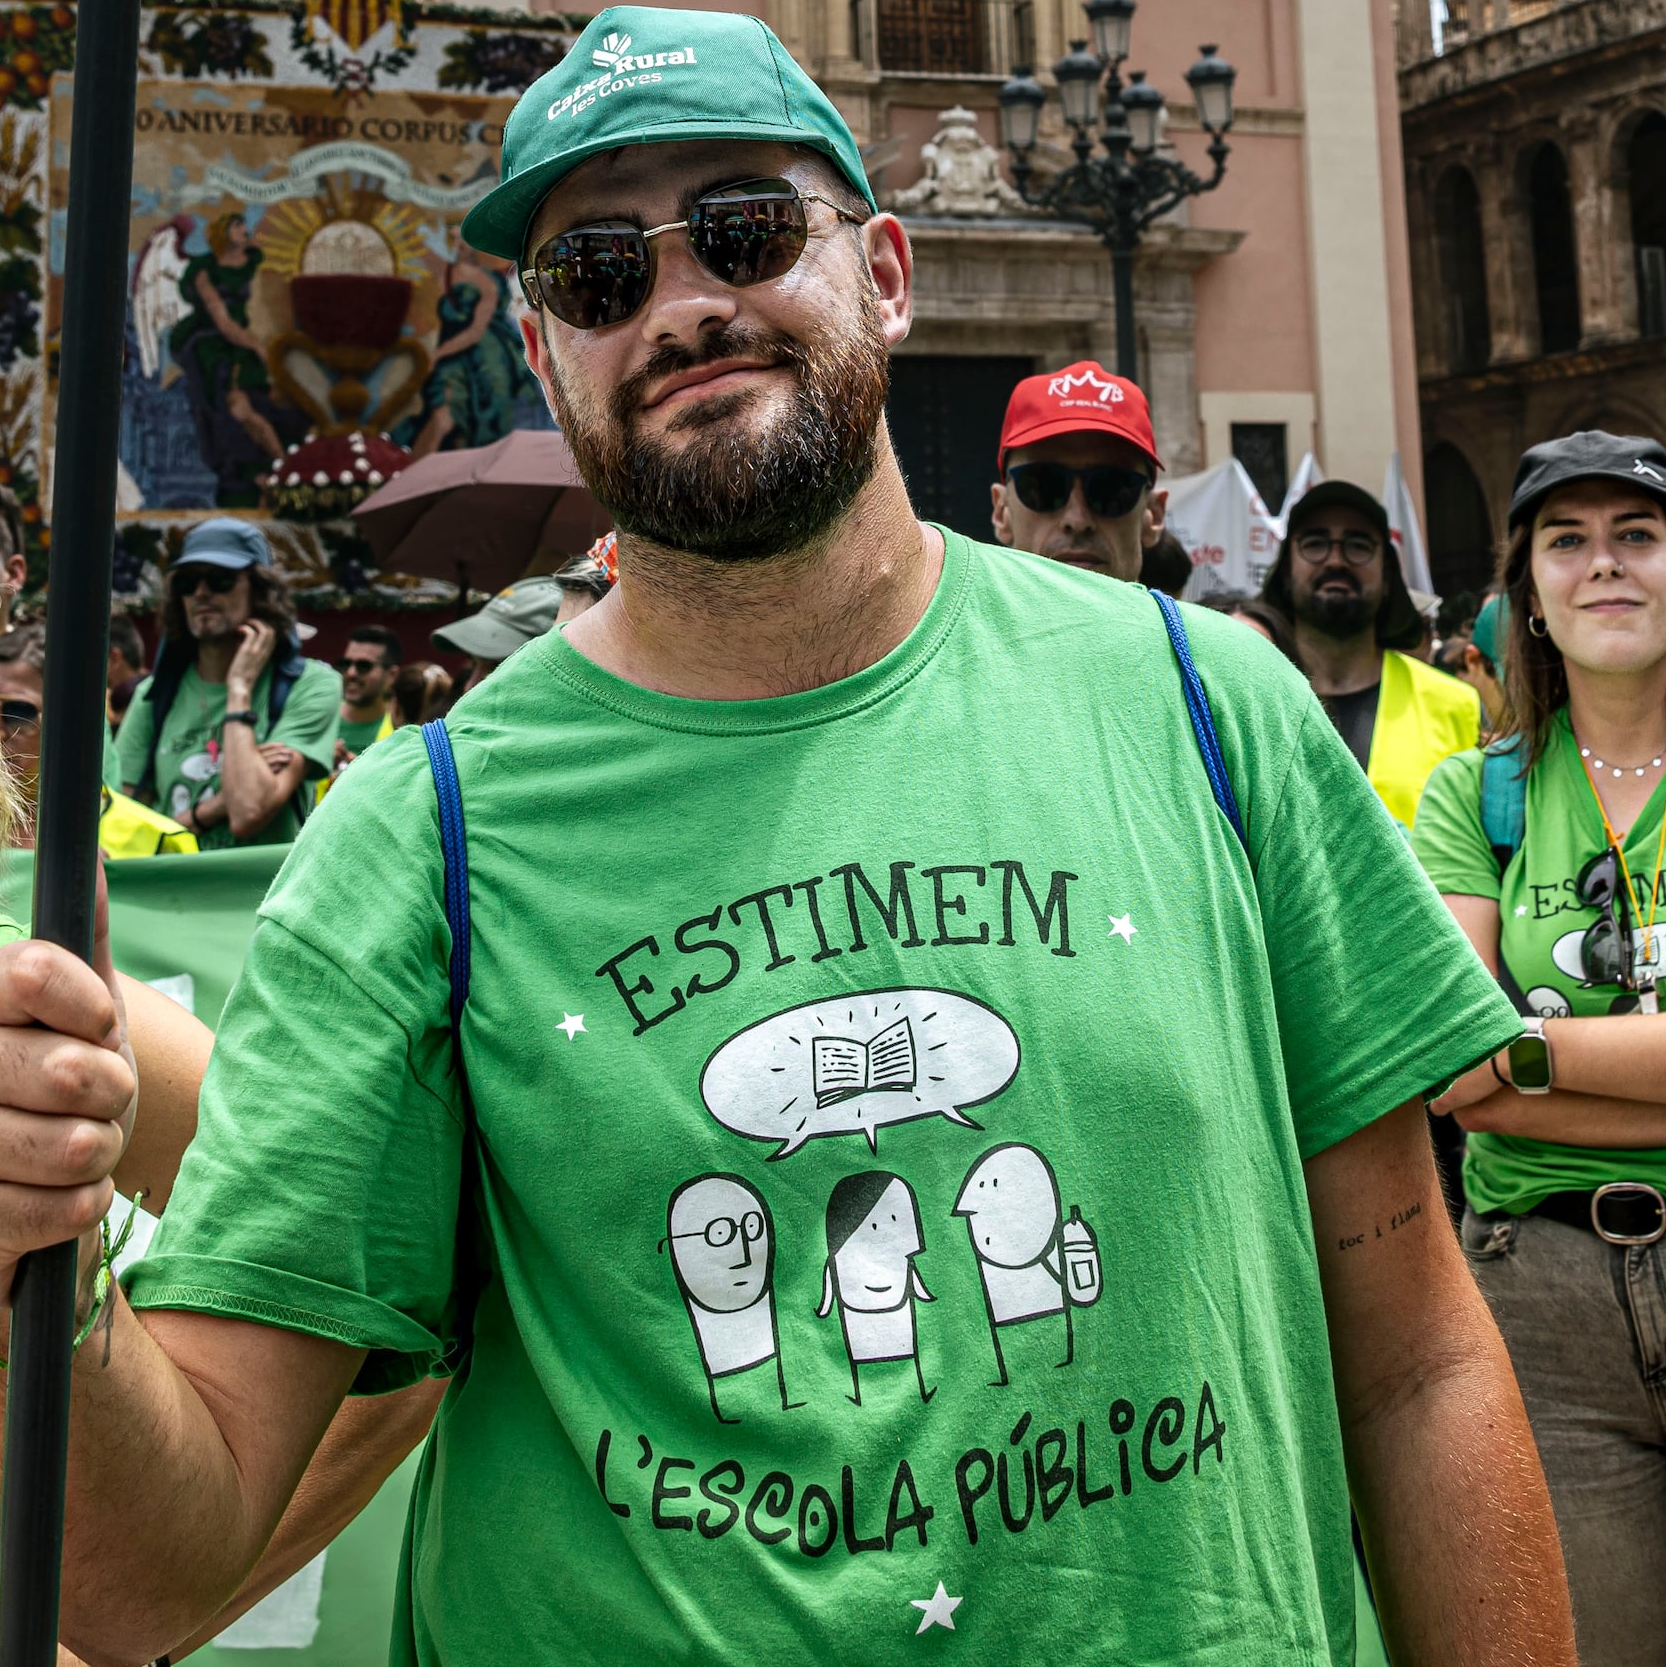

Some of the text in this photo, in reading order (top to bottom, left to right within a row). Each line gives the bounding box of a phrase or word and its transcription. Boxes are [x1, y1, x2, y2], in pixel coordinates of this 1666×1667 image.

[547, 47, 697, 121] Caixa Rural
[571, 72, 663, 118] les Coves
[157, 109, 352, 140] ANIVERSARIO
[360, 117, 471, 146] CORPUS
[595, 860, 1079, 1038] ESTIMEM
[595, 1428, 935, 1558] L'ESCOLA
